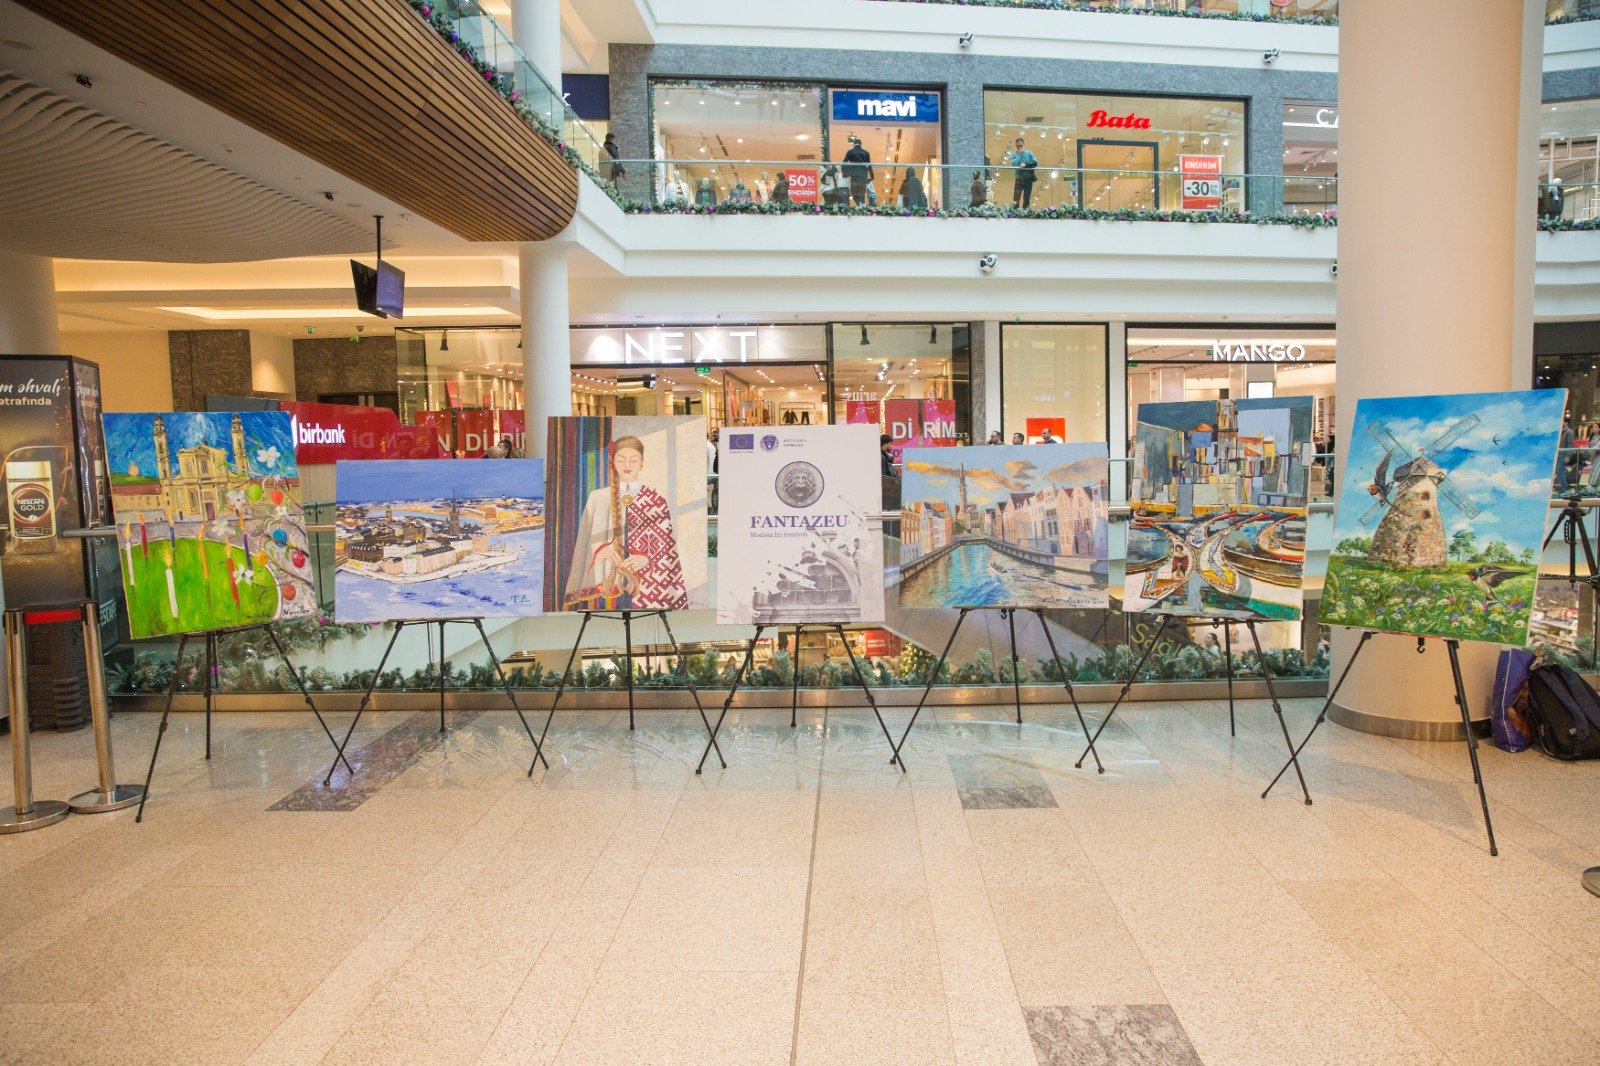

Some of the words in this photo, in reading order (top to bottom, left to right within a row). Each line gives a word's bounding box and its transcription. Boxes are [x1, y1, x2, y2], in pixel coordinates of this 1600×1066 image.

[857, 96, 916, 117] mavi
[1087, 110, 1152, 129] Bata
[1185, 161, 1217, 169] ENDİRİM
[788, 175, 815, 186] 50%
[624, 332, 757, 363] NEXT
[1212, 343, 1305, 361] MANGO
[299, 422, 346, 444] birbank
[750, 515, 848, 528] FANTAZEU
